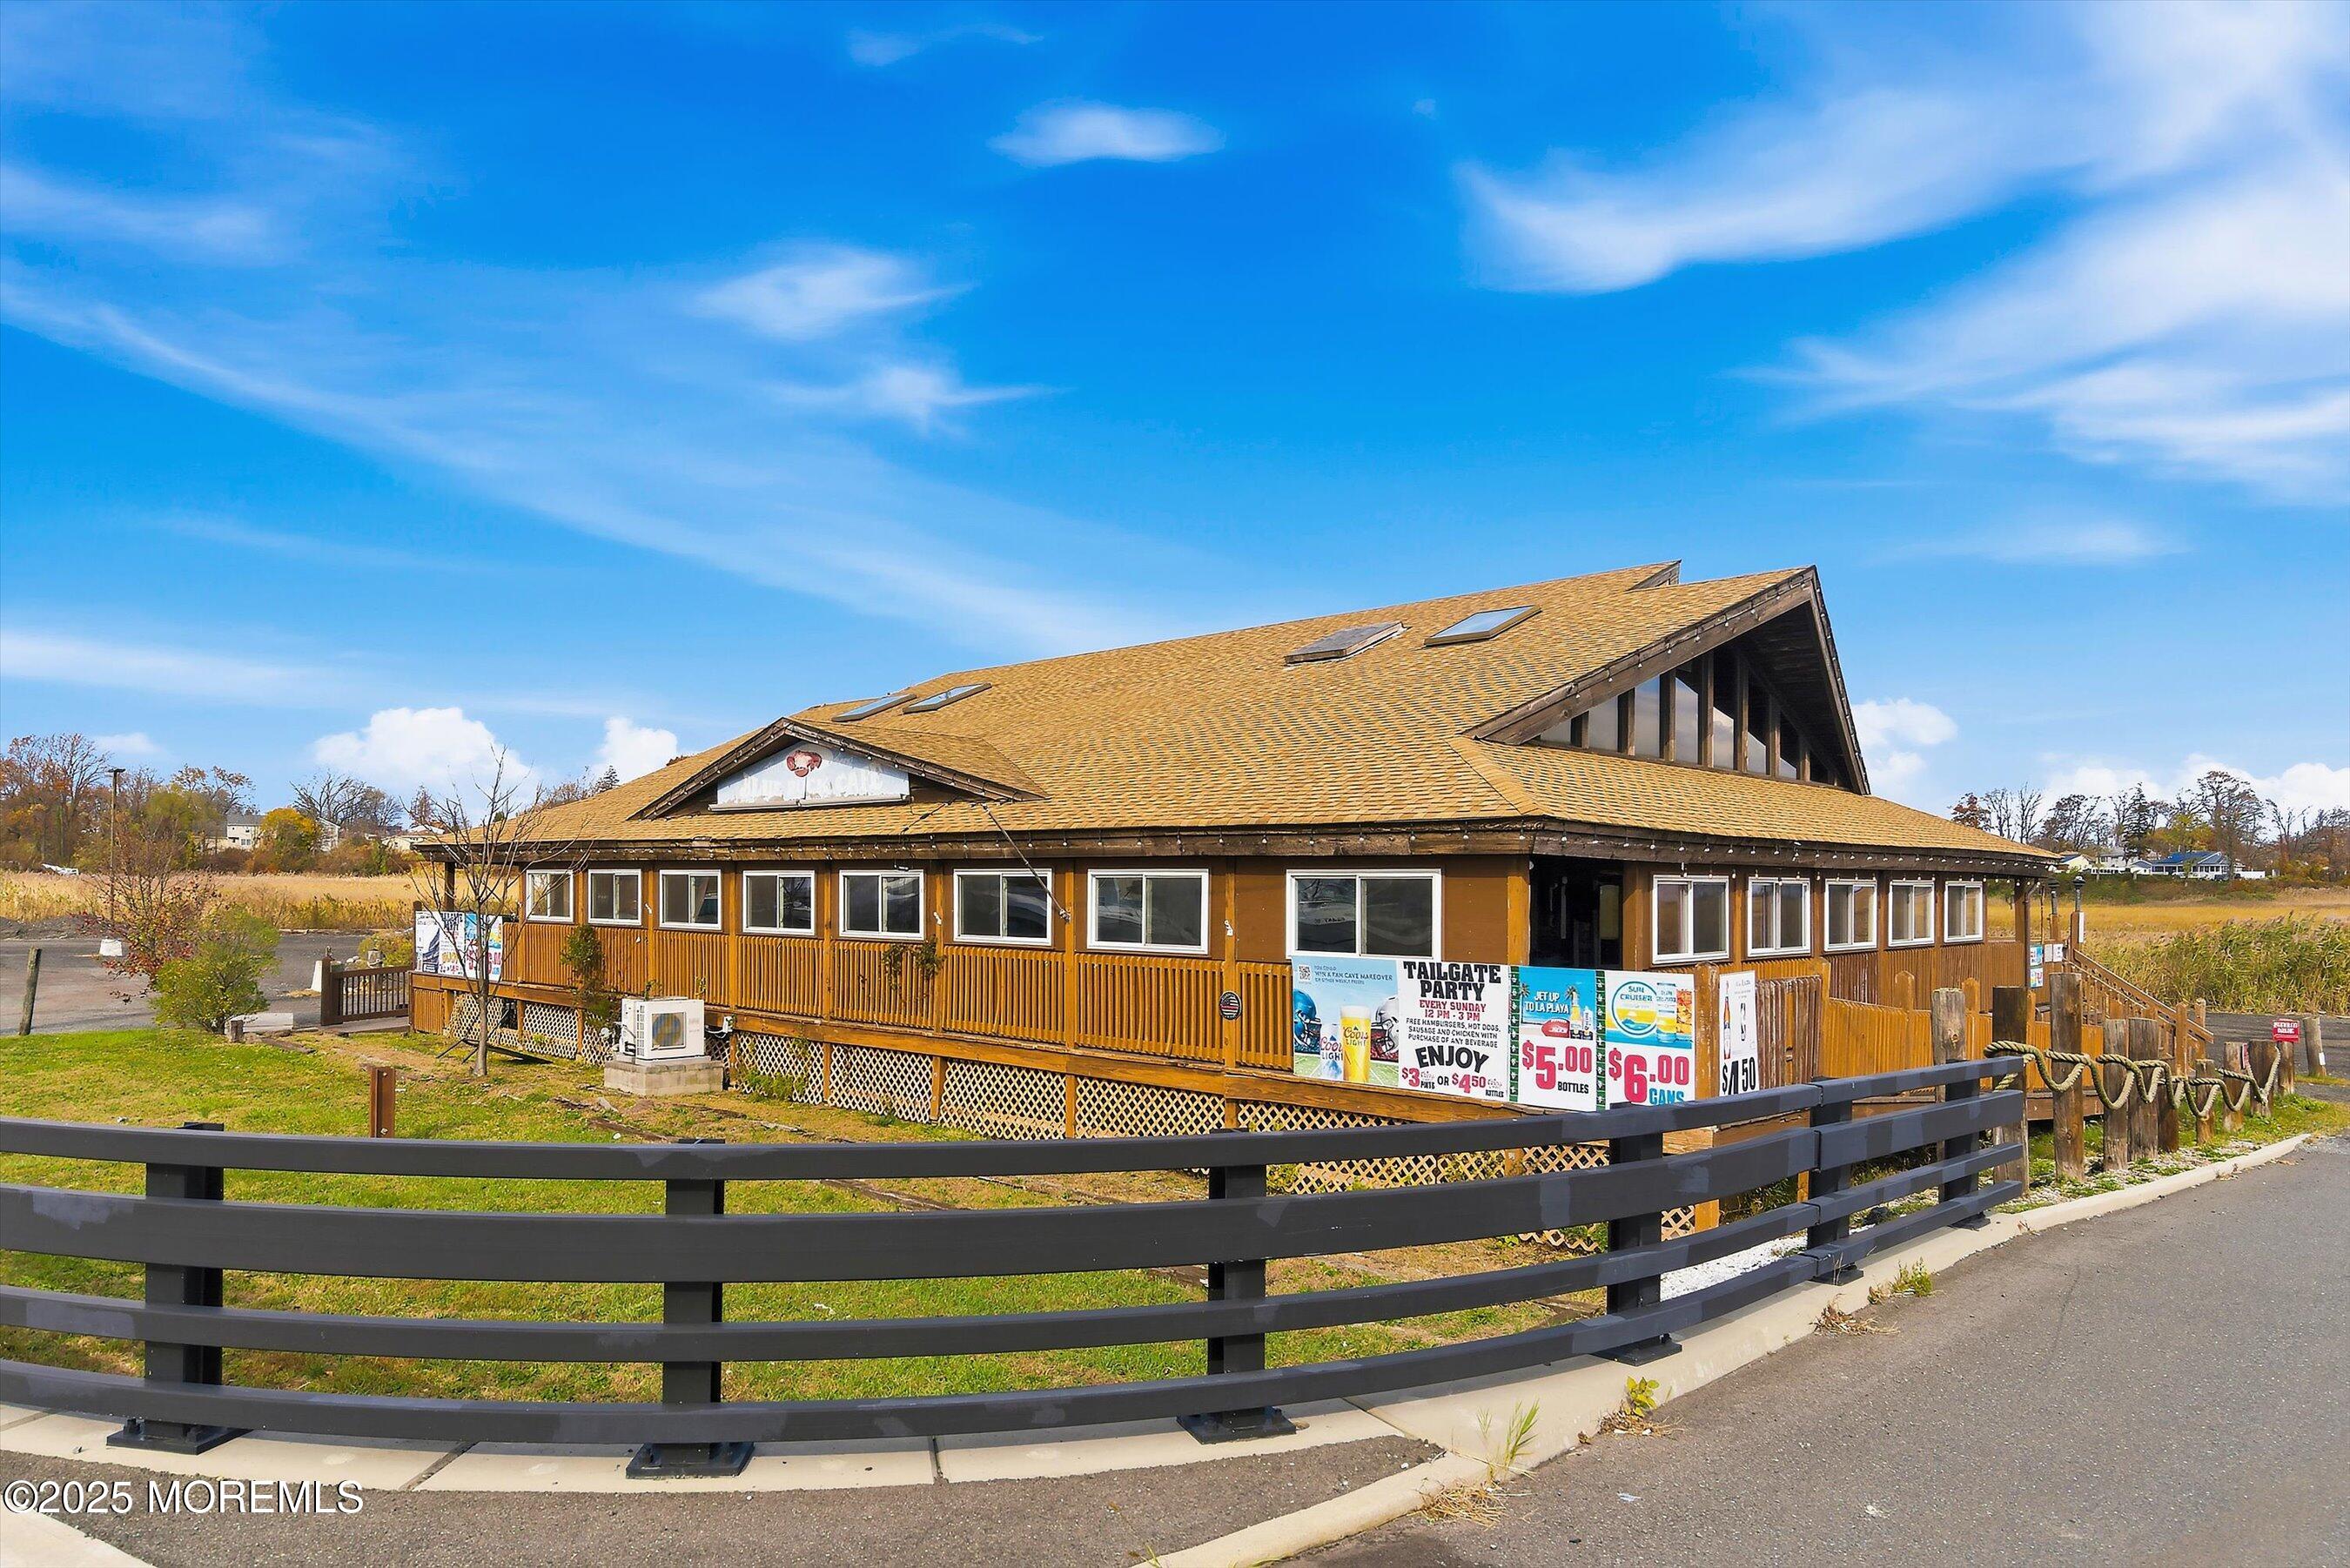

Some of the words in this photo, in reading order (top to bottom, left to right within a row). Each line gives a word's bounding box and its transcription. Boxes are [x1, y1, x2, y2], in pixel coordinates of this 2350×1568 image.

[1403, 961, 1501, 984] TAILGATE
[1420, 980, 1485, 1002] PARTY
[1534, 991, 1548, 1002] JET
[1549, 992, 1560, 1002] UP
[1419, 999, 1447, 1009] EVERY
[1450, 1002, 1486, 1013] SUNDAY
[1525, 1001, 1534, 1010] TO
[1534, 1002, 1546, 1012] LA
[1546, 1003, 1569, 1015] PLAYA
[1425, 1009, 1434, 1018] 12
[1437, 1010, 1450, 1019] PM
[1467, 1012, 1480, 1022] PM
[1408, 1026, 1436, 1035] SAUSAGE
[1451, 1029, 1480, 1038] CHICKEN
[1408, 1034, 1440, 1042] PURCHASE
[1465, 1039, 1498, 1049] BEVERAGE
[1415, 1045, 1489, 1074] ENJOY
[1522, 1040, 1592, 1089] $5.00
[1401, 1067, 1420, 1088] $3
[1437, 1075, 1449, 1086] OR
[1608, 1048, 1689, 1103] $6.00
[1557, 1082, 1589, 1094] BOTTLES
[1648, 1088, 1685, 1106] CANS
